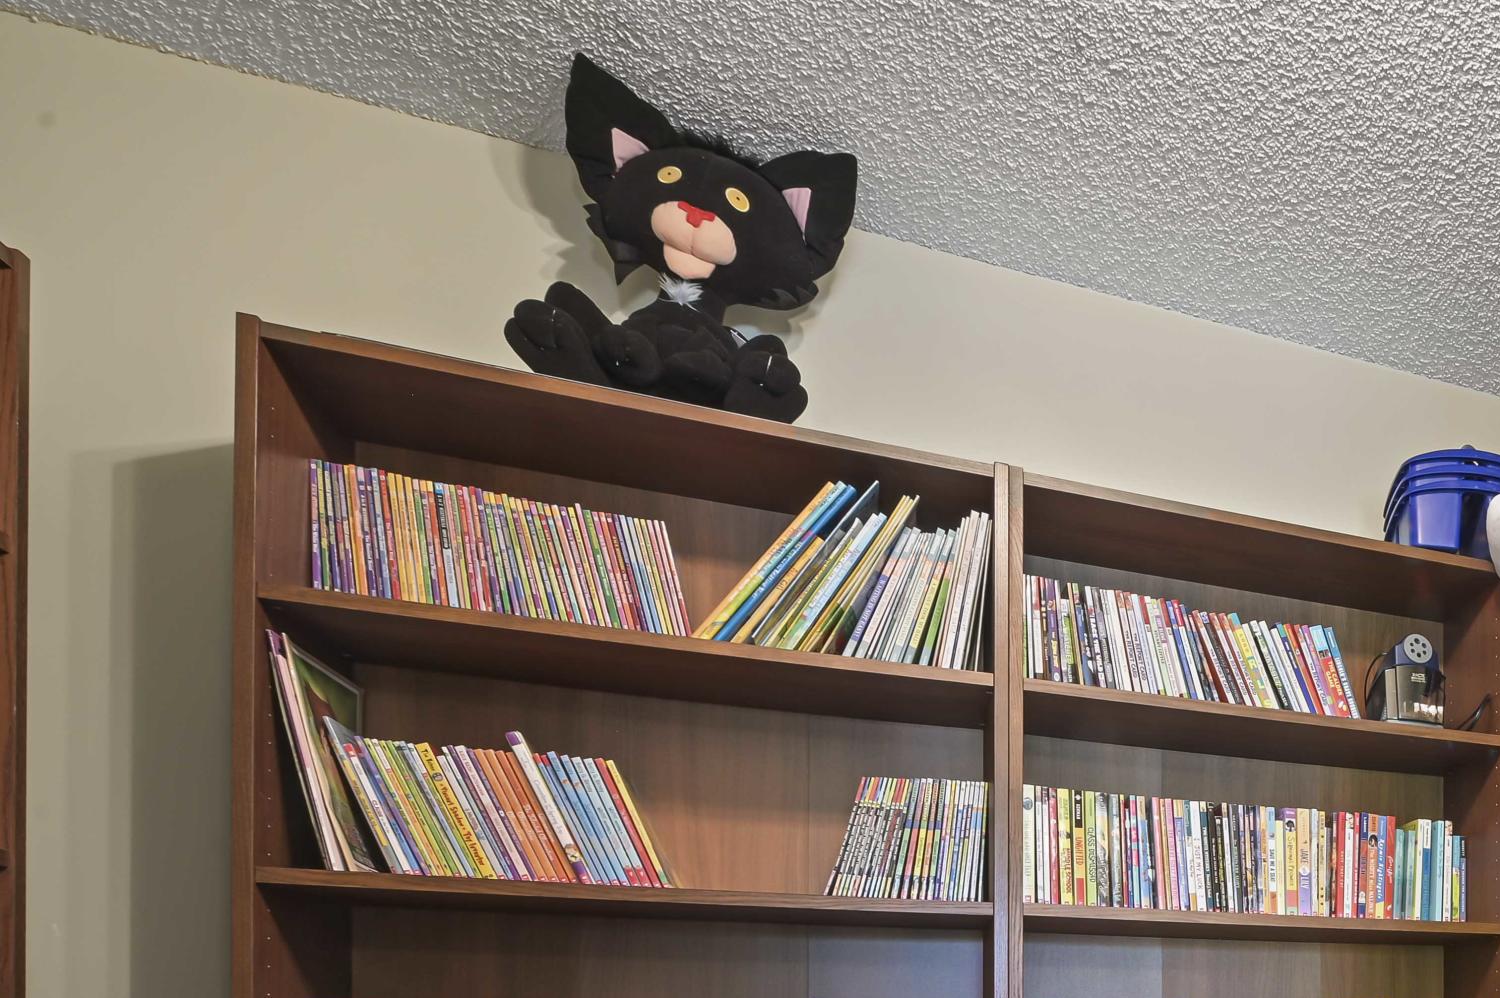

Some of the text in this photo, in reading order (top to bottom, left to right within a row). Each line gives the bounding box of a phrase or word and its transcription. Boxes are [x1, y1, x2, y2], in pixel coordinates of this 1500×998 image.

[1326, 660, 1342, 696] THE CALDER
[1074, 837, 1083, 865] UNGIFTED
[1299, 848, 1309, 864] JAKE
